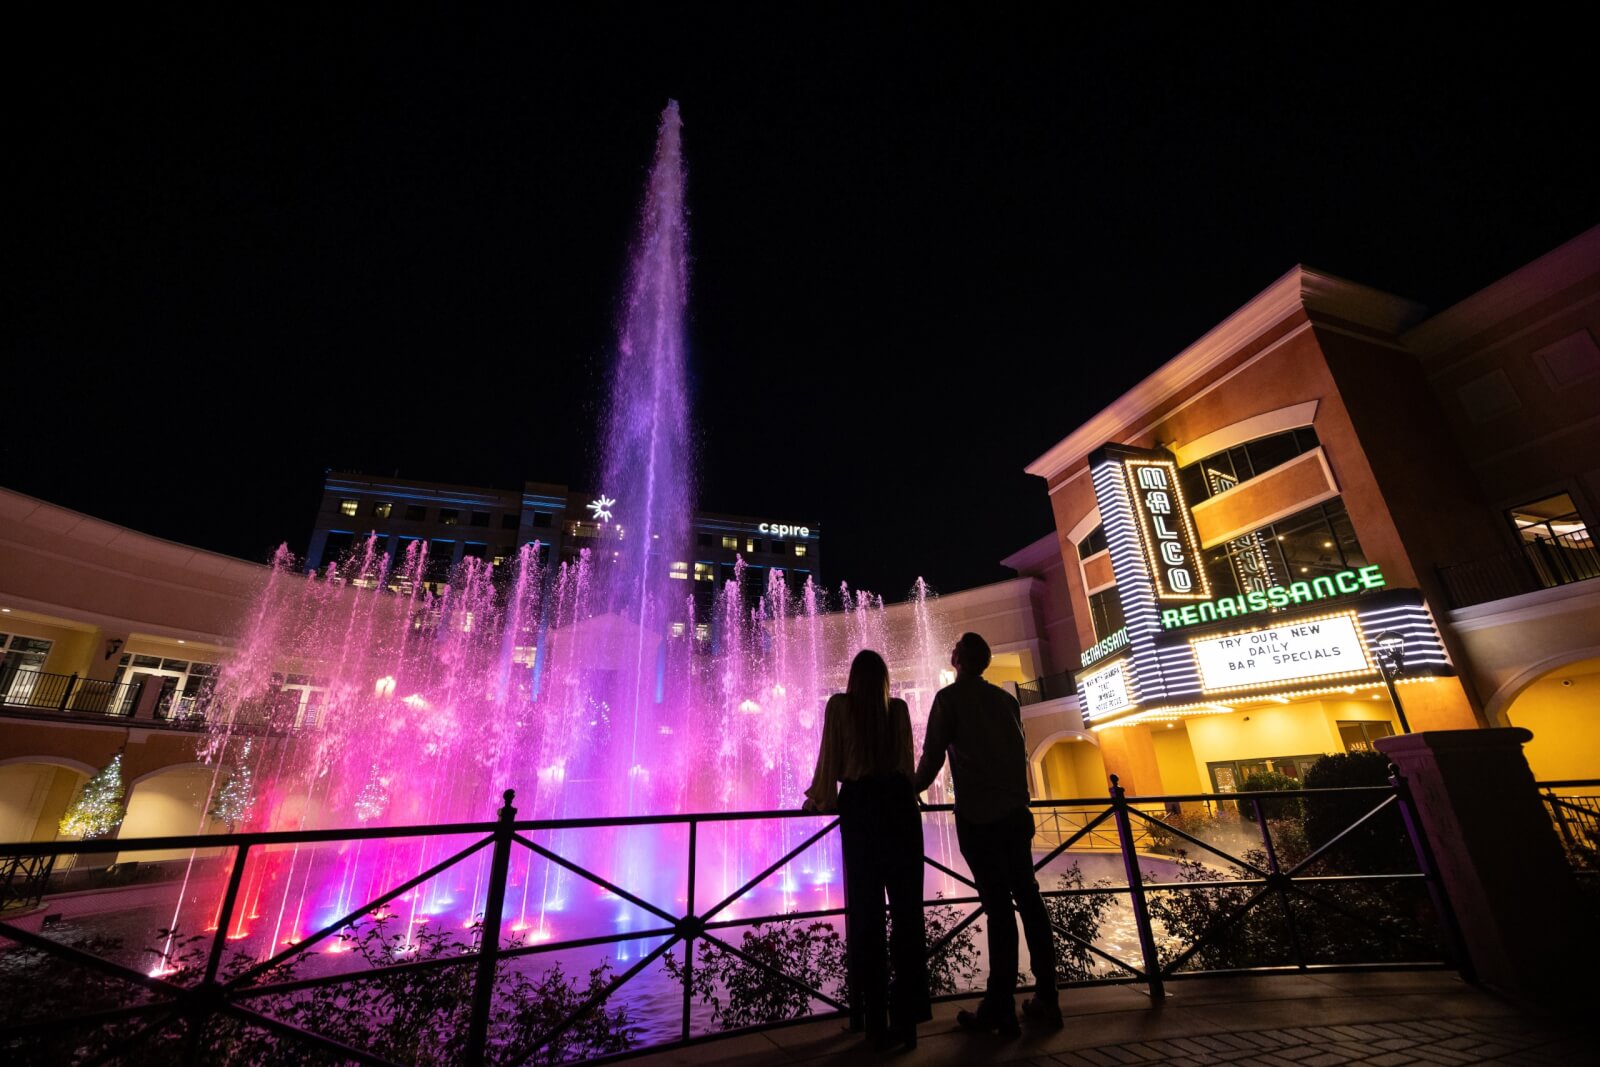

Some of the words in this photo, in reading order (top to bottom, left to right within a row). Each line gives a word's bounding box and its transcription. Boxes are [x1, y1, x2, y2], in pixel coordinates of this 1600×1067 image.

[1137, 467, 1191, 593] MALCO
[1161, 565, 1385, 630] RENAISSANCE
[1081, 626, 1130, 667] RENAISSANC
[1219, 638, 1242, 650] TRY
[1251, 631, 1279, 644] OUR
[1291, 624, 1321, 638] NEW
[1249, 641, 1289, 657] DAILY
[1228, 659, 1256, 671] BAR
[1273, 646, 1341, 664] SPECIALS
